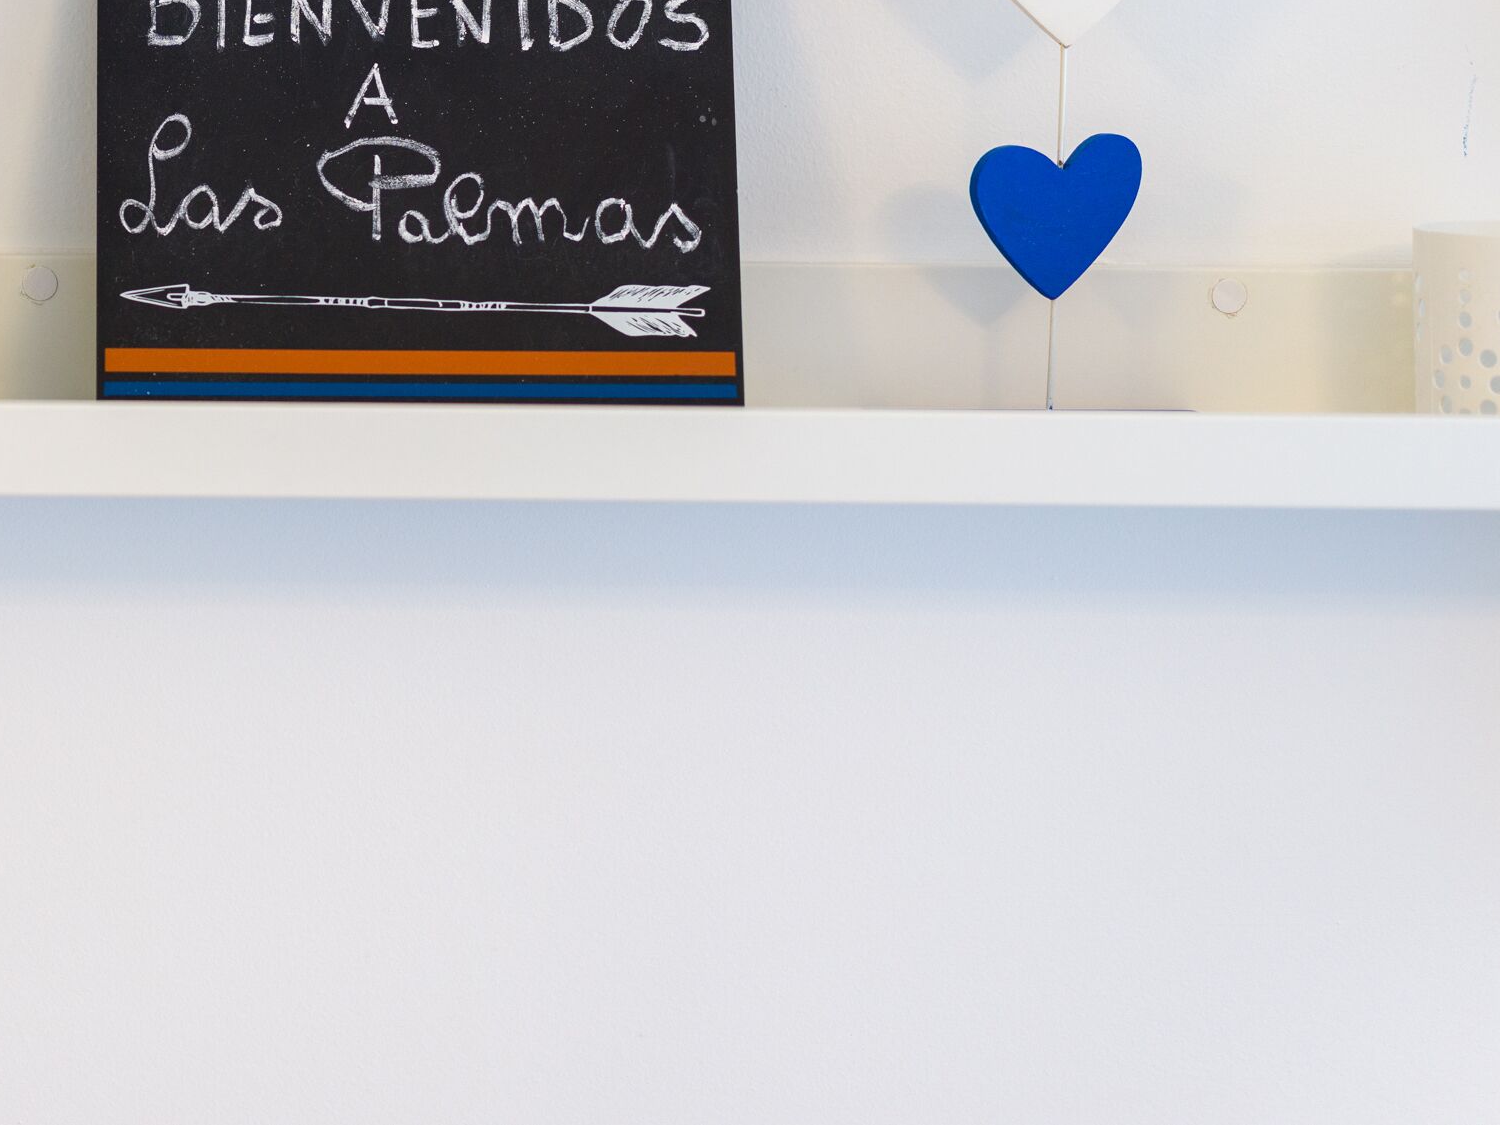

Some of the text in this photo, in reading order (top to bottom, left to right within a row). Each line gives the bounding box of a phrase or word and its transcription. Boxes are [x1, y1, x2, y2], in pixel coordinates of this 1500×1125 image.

[343, 62, 399, 129] A
[118, 113, 704, 254] Las Palmas
